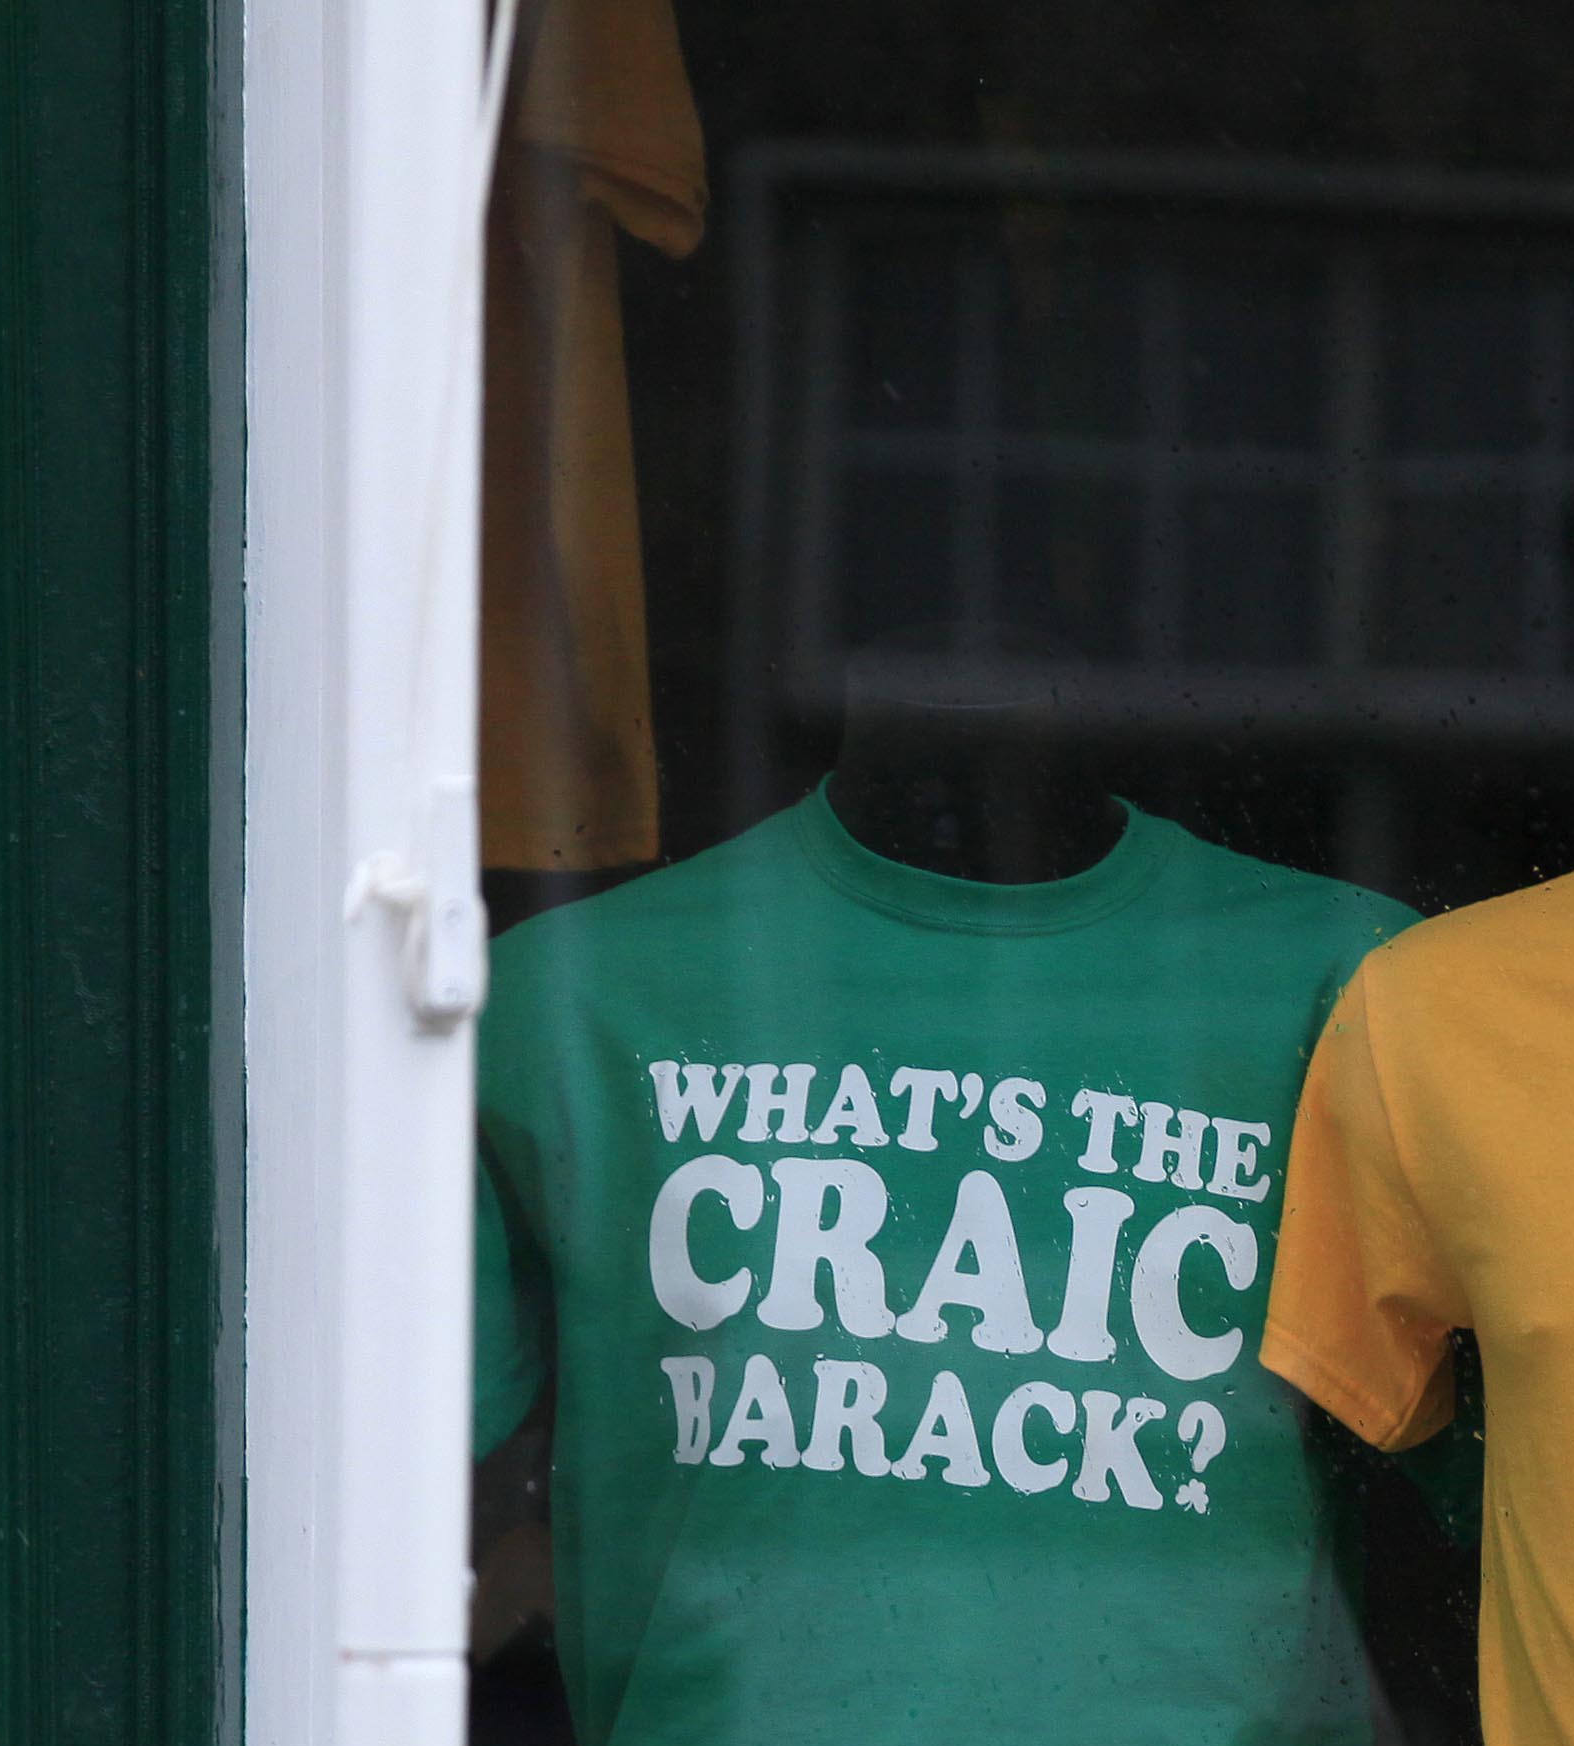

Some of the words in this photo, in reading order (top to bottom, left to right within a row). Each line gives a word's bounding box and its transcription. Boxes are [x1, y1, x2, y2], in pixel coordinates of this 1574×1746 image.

[648, 1059, 1046, 1162] WHAT'S
[1071, 1087, 1271, 1202] THE
[648, 1153, 1258, 1381] CRAIC
[659, 1353, 1227, 1516] BARACK?
